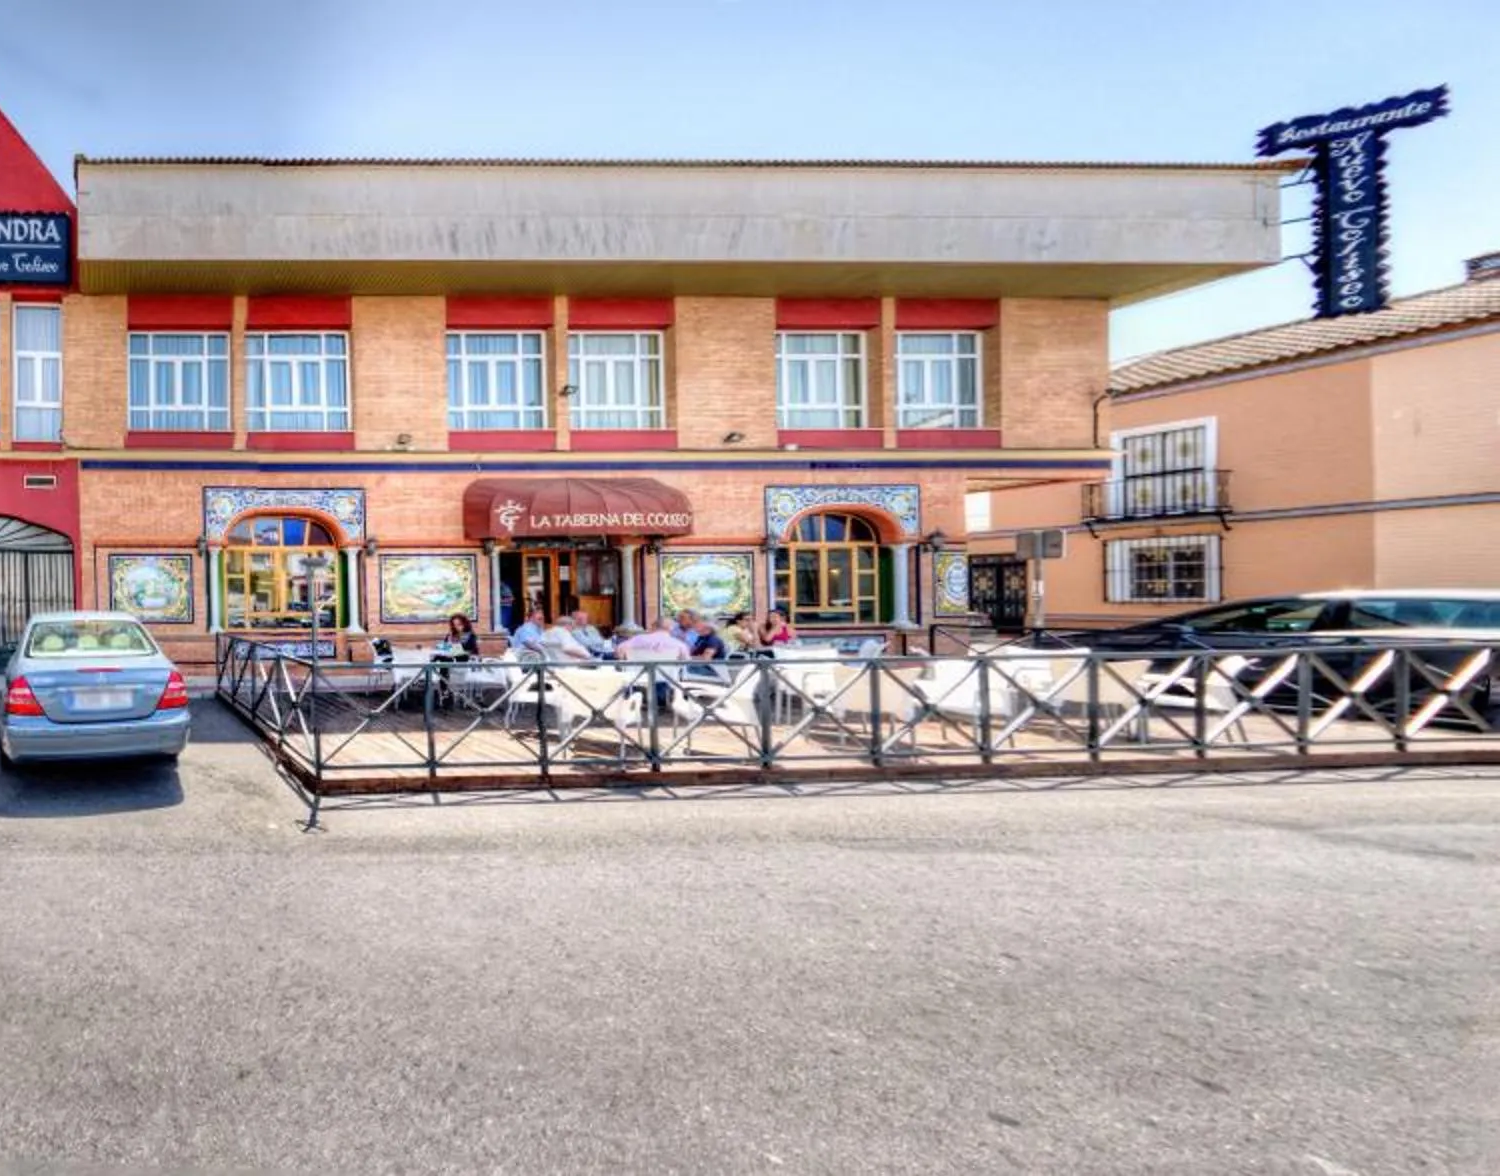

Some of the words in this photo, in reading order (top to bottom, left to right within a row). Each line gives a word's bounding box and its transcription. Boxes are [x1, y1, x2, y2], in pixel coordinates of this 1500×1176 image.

[1330, 205, 1376, 308] Coliseo
[530, 515, 551, 529] LA
[551, 512, 621, 528] TABERNA
[622, 512, 647, 527] DEL
